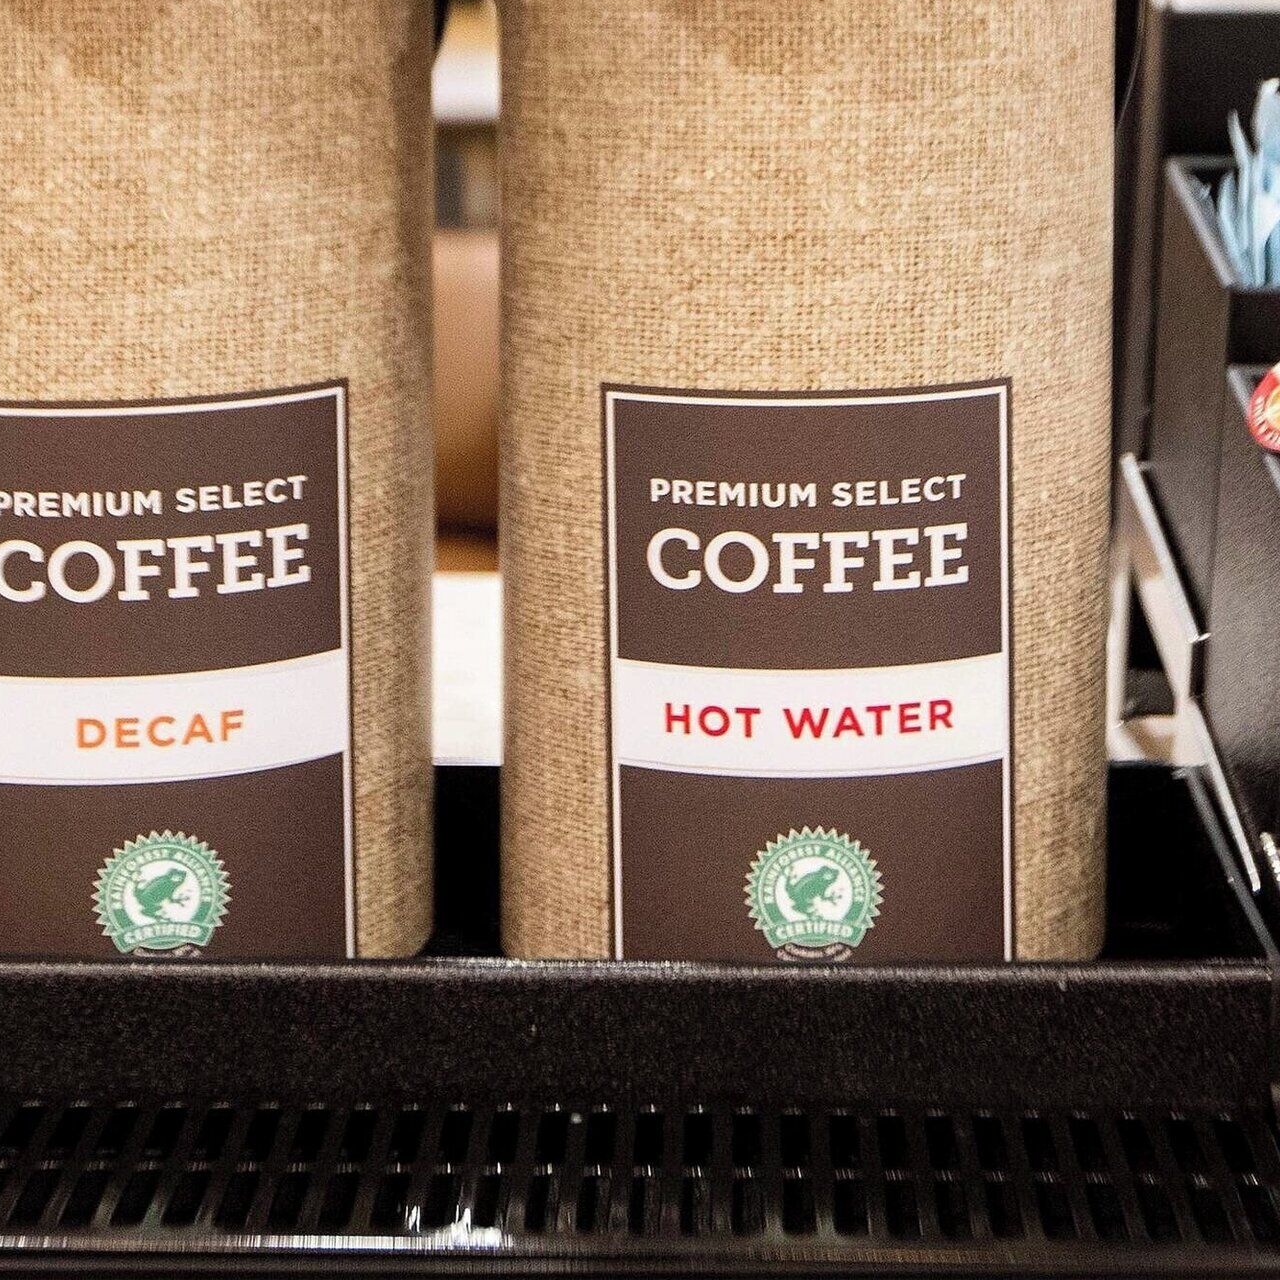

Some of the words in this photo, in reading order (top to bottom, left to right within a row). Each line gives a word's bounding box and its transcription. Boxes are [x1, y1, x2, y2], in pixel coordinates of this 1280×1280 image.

[175, 474, 308, 513] SELECT
[650, 477, 817, 508] PREMIUM
[831, 472, 967, 508] SELECT
[646, 521, 970, 594] COFFEE
[75, 708, 245, 750] DECAF
[663, 701, 761, 739] HOT
[783, 698, 955, 740] WATER
[775, 920, 854, 940] CERTIFIED
